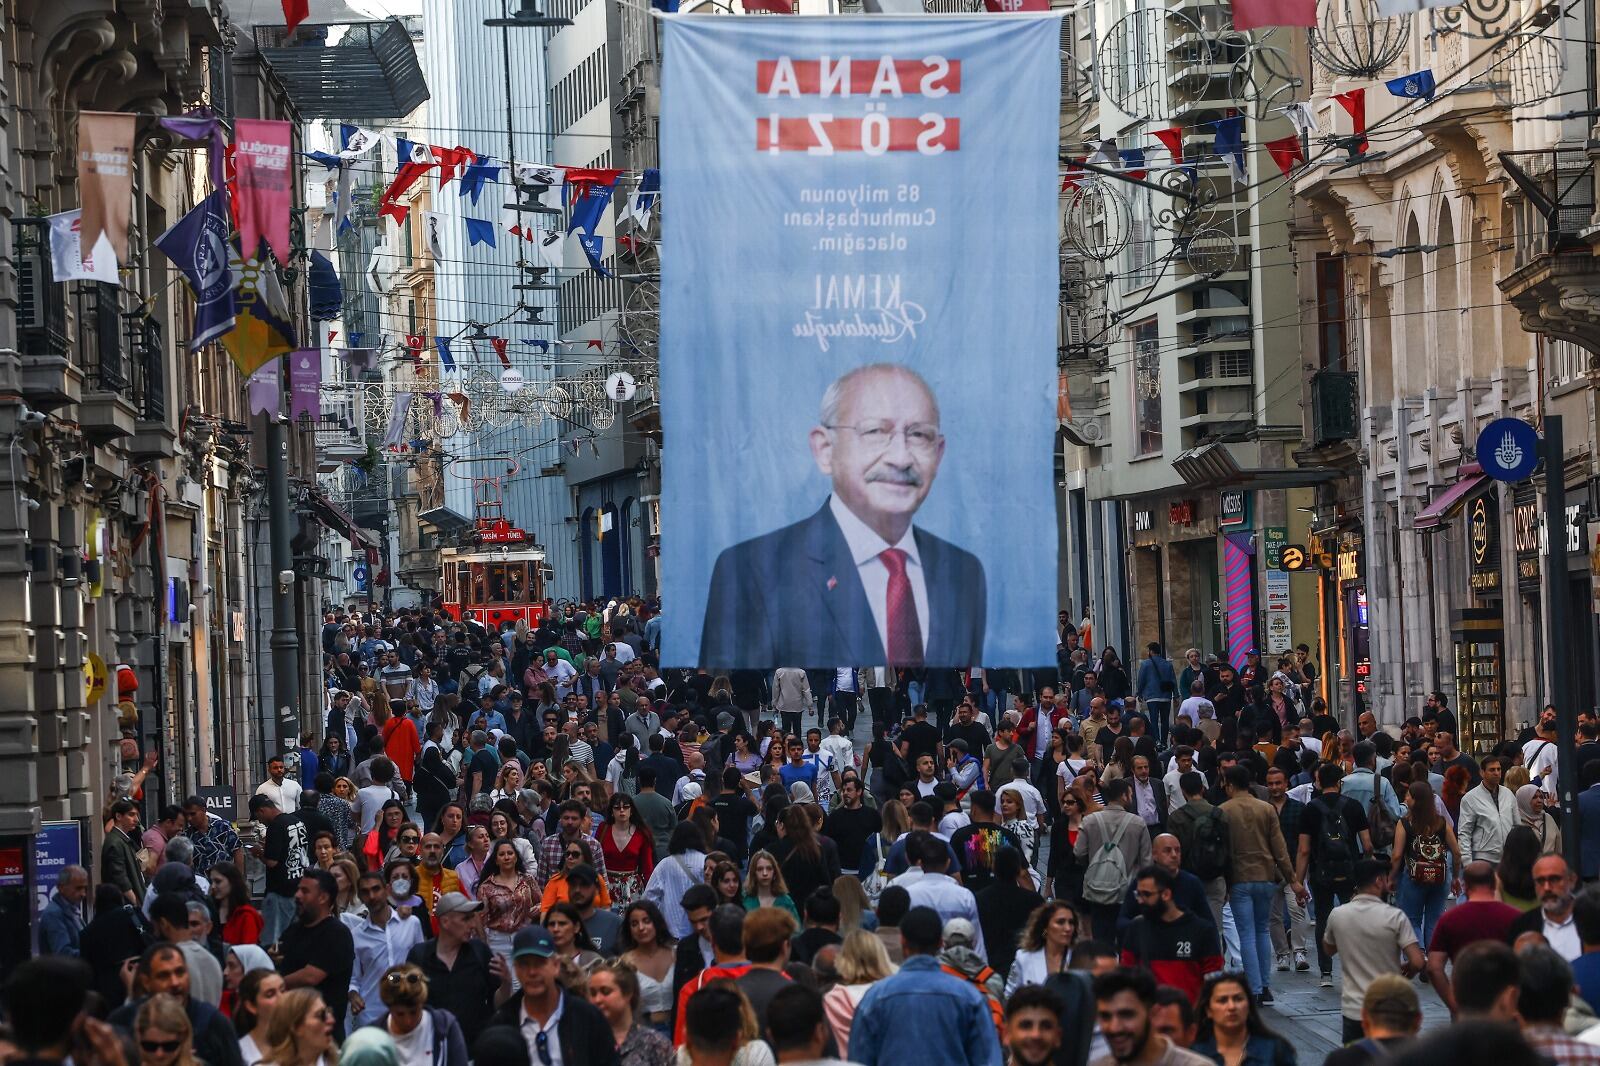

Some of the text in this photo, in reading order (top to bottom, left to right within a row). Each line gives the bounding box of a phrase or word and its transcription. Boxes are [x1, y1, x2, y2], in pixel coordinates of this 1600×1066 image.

[499, 521, 503, 529] 1
[1513, 504, 1537, 551] LORIS
[507, 531, 522, 539] TÜNEL
[201, 795, 232, 809] ALE
[1176, 941, 1191, 954] 28
